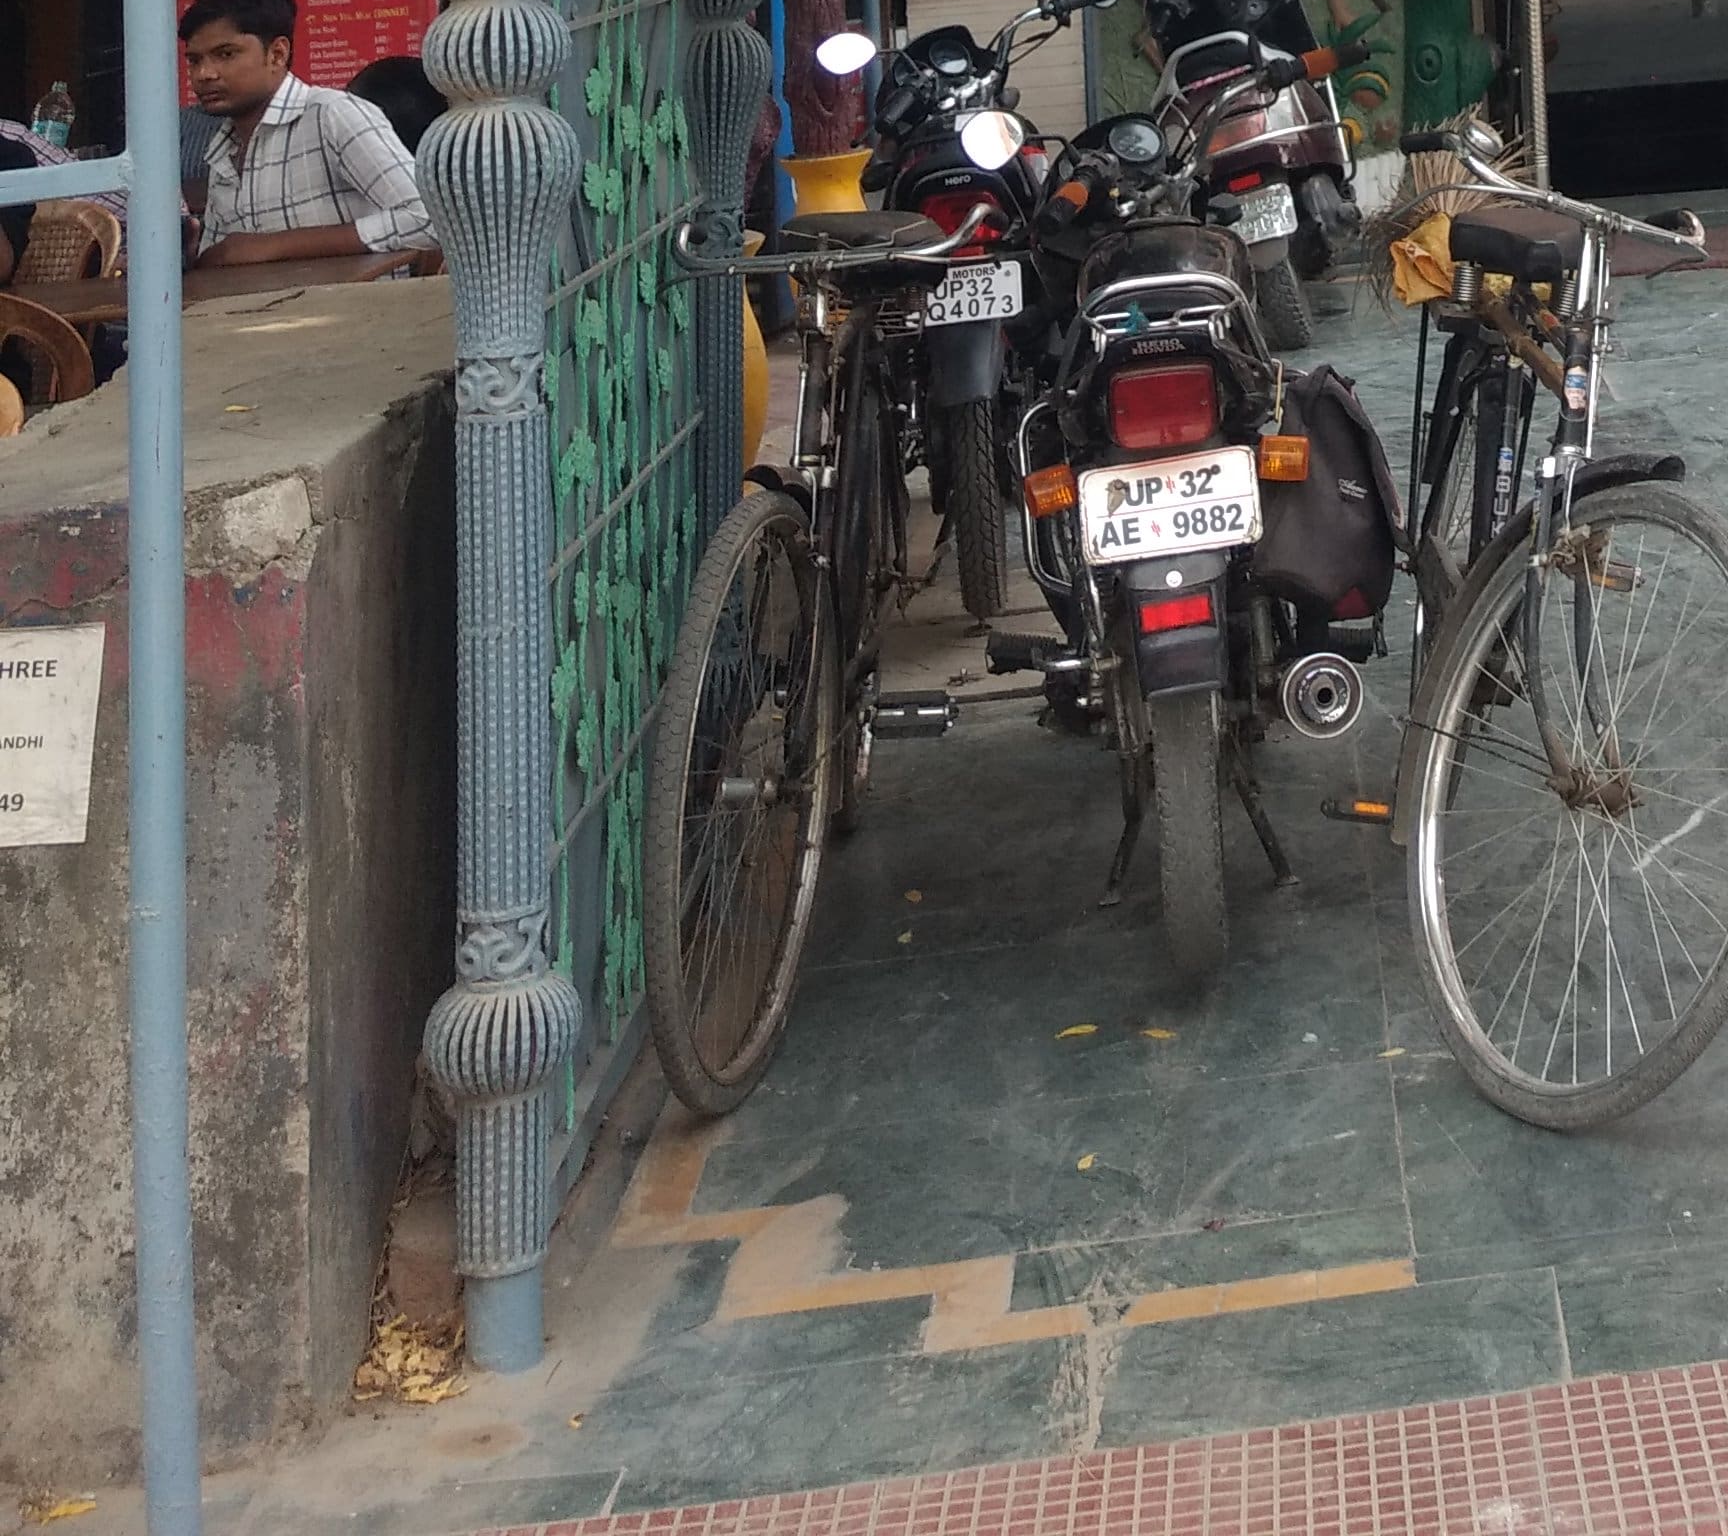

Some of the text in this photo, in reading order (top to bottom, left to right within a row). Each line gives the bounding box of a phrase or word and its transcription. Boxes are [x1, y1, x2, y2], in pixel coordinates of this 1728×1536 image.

[952, 265, 996, 280] MOTORS
[1124, 470, 1214, 507] UP 32
[1100, 502, 1245, 549] AE 9882
